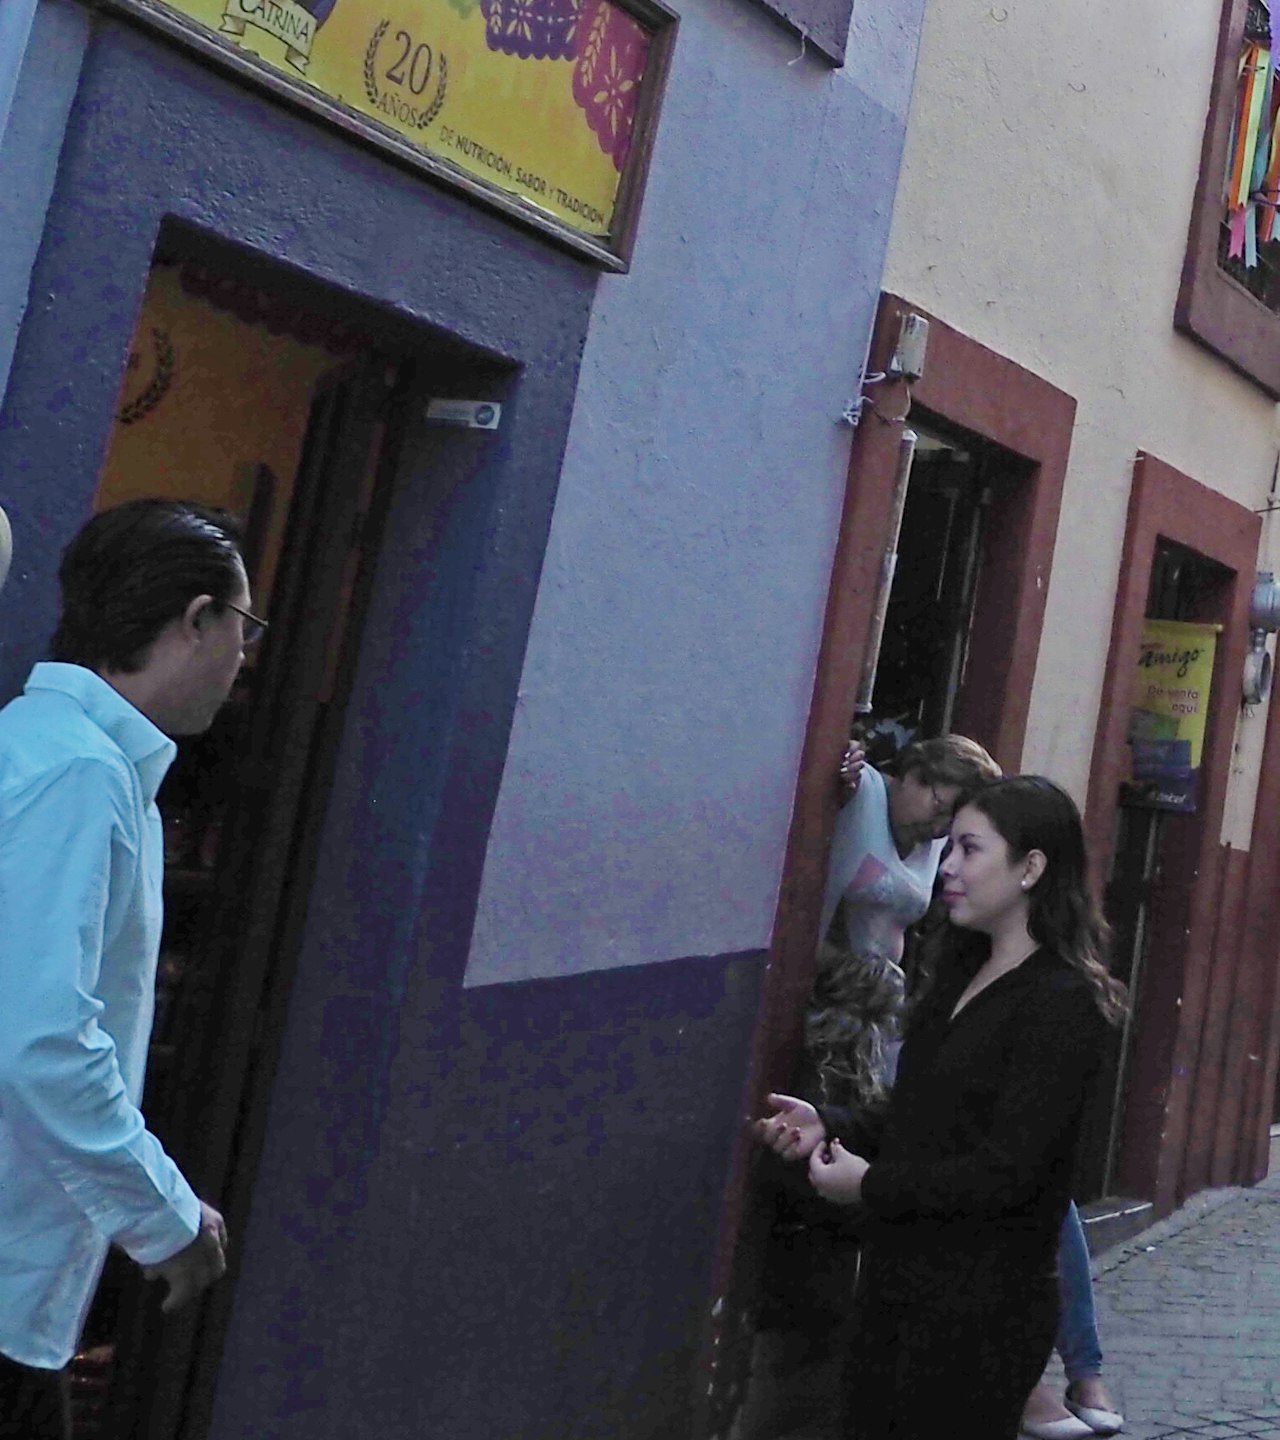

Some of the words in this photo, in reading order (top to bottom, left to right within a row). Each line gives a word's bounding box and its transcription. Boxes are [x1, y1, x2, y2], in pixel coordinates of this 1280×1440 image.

[386, 30, 432, 95] 20
[376, 91, 419, 127] AÑOS
[439, 124, 454, 142] DE
[516, 167, 547, 196] SABOR
